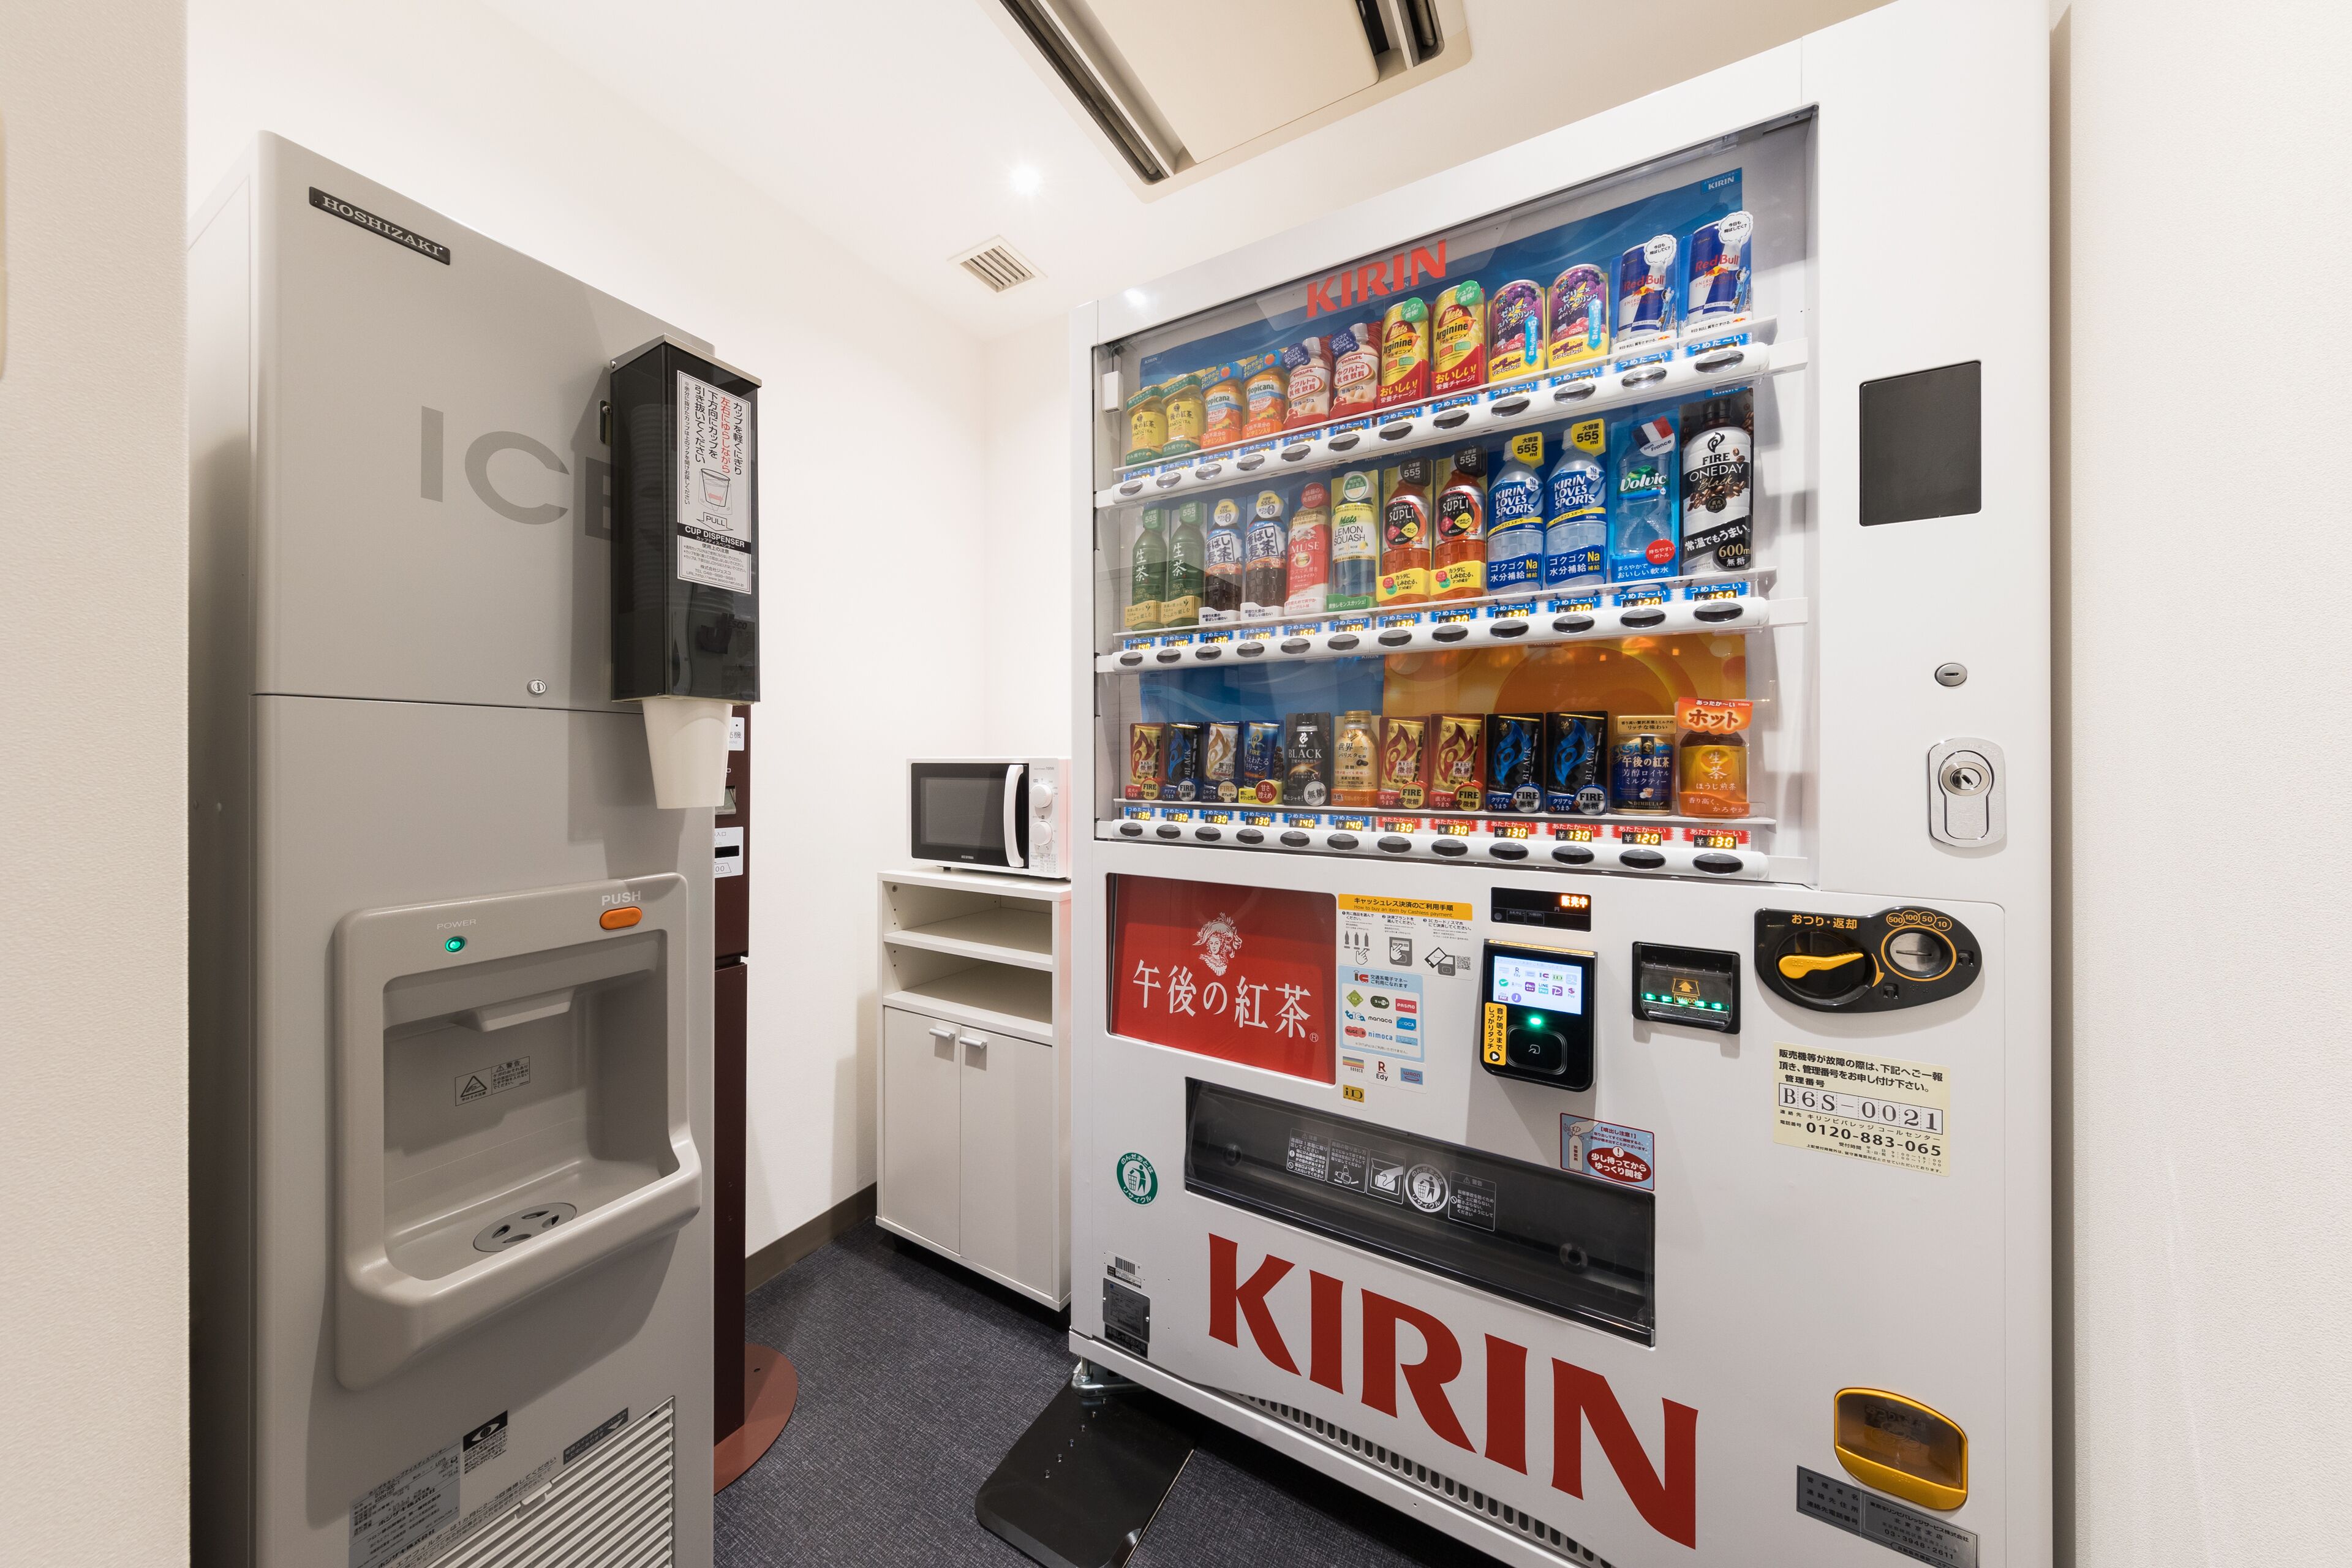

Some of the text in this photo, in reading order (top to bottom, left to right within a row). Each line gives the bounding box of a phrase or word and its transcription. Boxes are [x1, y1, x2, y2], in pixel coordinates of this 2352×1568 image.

[1708, 176, 1735, 190] KIRIN
[323, 195, 440, 256] HOSHIZAKI
[1695, 254, 1740, 272] Red Bull
[1306, 238, 1446, 318] KIRIN
[1624, 274, 1665, 292] Red Bull
[1436, 321, 1468, 341] Arginine
[1383, 337, 1412, 356] Arginine
[1337, 364, 1365, 377] ヤクルトの
[1337, 371, 1365, 383] 乳性飲料
[1247, 383, 1275, 395] Tropicana
[1289, 378, 1316, 389] ヤクルトの
[1289, 383, 1316, 396] 乳性飲料
[1436, 374, 1475, 391] 栄養チャージ!
[1205, 395, 1230, 405] Tropicana
[1381, 390, 1416, 404] 栄養チャージ!
[695, 385, 705, 464] 引き抜いてください
[708, 390, 718, 459] 下方向にカップを
[720, 396, 731, 474] 左右にゆらしながら
[733, 402, 744, 475] カップを軽くにぎり
[1576, 431, 1599, 443] 555
[1517, 443, 1538, 453] 555
[1650, 439, 1672, 453] France
[1460, 454, 1477, 464] 555
[1702, 452, 1730, 466] FIRE
[1404, 467, 1421, 477] 555
[1689, 464, 1744, 482] ONEDAY
[1554, 475, 1585, 492] KIRIN
[1619, 472, 1667, 492] Volvic
[1698, 475, 1734, 491] Black
[1495, 485, 1525, 501] KIRIN
[1555, 485, 1588, 501] LOVES
[1442, 499, 1468, 513] SUPLI
[1496, 495, 1527, 510] LOVES
[1555, 494, 1595, 510] SPORTS
[1389, 509, 1414, 522] SUPLI
[1496, 503, 1534, 518] SPORTS
[706, 515, 726, 527] PULL
[685, 526, 745, 548] CUP DISPENSER
[1334, 526, 1363, 538] LEMON
[1684, 524, 1751, 551] 常温でもうまい。
[1333, 533, 1365, 546] SQUASH
[1172, 542, 1187, 577] 生茶
[1549, 554, 1585, 567] ゴクゴク
[1587, 551, 1600, 562] Na
[1726, 557, 1745, 567] 無糖
[1135, 549, 1149, 582] 生茶
[1490, 561, 1525, 573] ゴクゴク
[1526, 559, 1537, 569] Na
[1548, 564, 1586, 577] 水分補給
[1490, 570, 1525, 582] 水分補給
[1617, 567, 1669, 579] おいしい軟水
[1328, 599, 1366, 609] 爽快レモンスカッシュ!
[1688, 709, 1738, 728] ホット
[1288, 748, 1323, 758] BLACK
[1623, 756, 1670, 768] 午後の紅茶
[1708, 752, 1727, 779] 生茶
[1307, 787, 1324, 800] 無糖
[1689, 797, 1719, 805] 香り高く、
[601, 891, 641, 906] PUSH
[1354, 897, 1453, 911] キャッシュレス決済のご利用手順
[1561, 895, 1588, 908] 販売中
[436, 919, 477, 930] POWER
[1791, 914, 1858, 930] おつり・返却
[1370, 974, 1408, 982] 交通系電子マネー
[1370, 979, 1408, 989] ご利用になれます
[1133, 959, 1311, 1038] 午後の紅茶
[1368, 1031, 1393, 1041] nimoca
[1779, 1049, 1943, 1082] 販売機等が故障の際は、下記へご一報
[1376, 1073, 1389, 1082] Edy
[1779, 1061, 1929, 1092] 頂き、管理番号をお申し付け下さい。
[1785, 1074, 1825, 1088] 管理番号
[1344, 1087, 1363, 1099] iD
[1780, 1109, 1802, 1118] 連絡先
[1806, 1122, 1942, 1156] 0120-883-065
[1839, 1142, 1862, 1151] 受付時間
[1121, 1154, 1153, 1174] のんだあとは
[1591, 1153, 1647, 1172] 少し待ってから
[1806, 1144, 1942, 1174] 上記受付時間外は、留守番電話対応とさせていただいております。
[1595, 1161, 1643, 1180] ゆっくり開栓
[1123, 1186, 1152, 1204] リサイクル
[1411, 1194, 1441, 1209] リサイクル
[1208, 1232, 1699, 1550] KIRIN
[1806, 1499, 1859, 1526] 連絡先電話番号
[1869, 1502, 1969, 1543] 東京キリンビバレッジサービス株式会社
